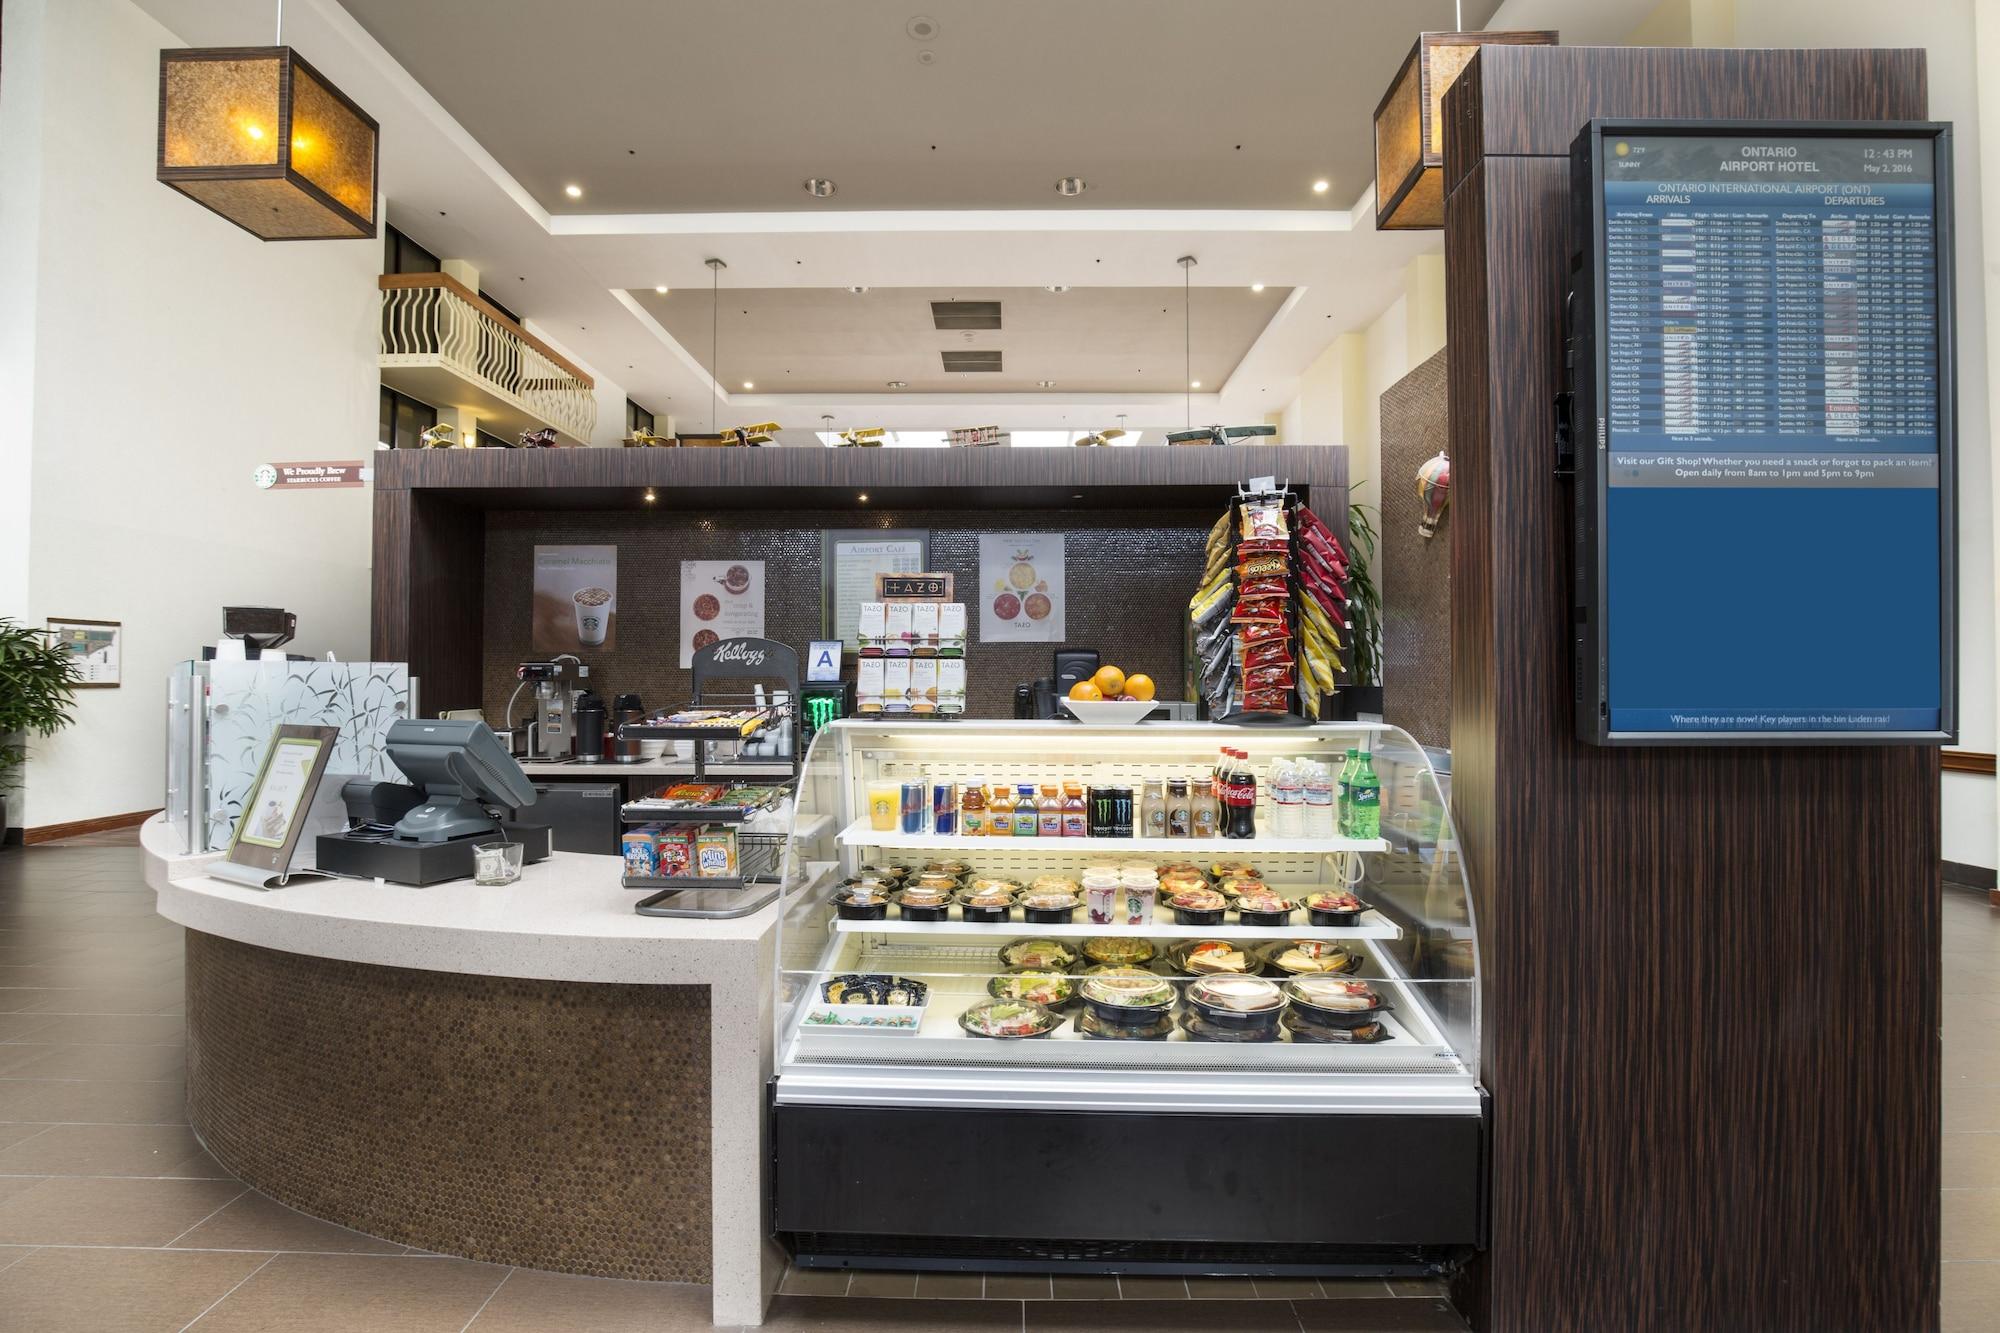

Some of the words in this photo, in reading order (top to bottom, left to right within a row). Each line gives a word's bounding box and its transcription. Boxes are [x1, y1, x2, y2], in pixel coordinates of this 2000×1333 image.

[1742, 146, 1797, 158] ONTARIO
[1898, 149, 1912, 158] PM
[1720, 161, 1775, 172] AIRPORT
[1778, 161, 1820, 172] HOTEL
[1864, 164, 1880, 174] May
[1882, 164, 1890, 174] 2,
[1892, 164, 1912, 173] 2016
[1658, 184, 1706, 193] ONTARIO
[1709, 184, 1792, 194] INTERNATIONAL
[1795, 184, 1839, 194] AIRPORT
[1842, 184, 1871, 196] (ONT)
[1646, 194, 1691, 204] ARRIVALS
[1824, 196, 1885, 206] DEPARTURES
[1617, 457, 1638, 465] Visit
[1657, 457, 1674, 465] Gift
[1676, 458, 1702, 467] Shop!
[1703, 458, 1742, 466] Whether
[1744, 460, 1761, 468] you
[1794, 458, 1818, 466] snack
[1832, 458, 1860, 468] forgot
[1873, 458, 1893, 468] pack
[1908, 458, 1932, 466] item!
[283, 468, 294, 476] We
[296, 467, 326, 476] Proudly
[327, 466, 346, 474] Brew
[1676, 469, 1700, 478] Open
[1702, 468, 1722, 478] daily
[1822, 470, 1840, 479] 5pm
[1855, 470, 1874, 479] 9pm
[1248, 559, 1280, 575] Cheetos
[817, 650, 832, 667] A
[1670, 714, 1700, 724] Where
[1702, 715, 1720, 725] they
[1760, 715, 1776, 725] Key
[1778, 715, 1806, 725] players
[1818, 715, 1832, 723] the
[1358, 792, 1375, 800] Sprite
[703, 850, 724, 860] Mini
